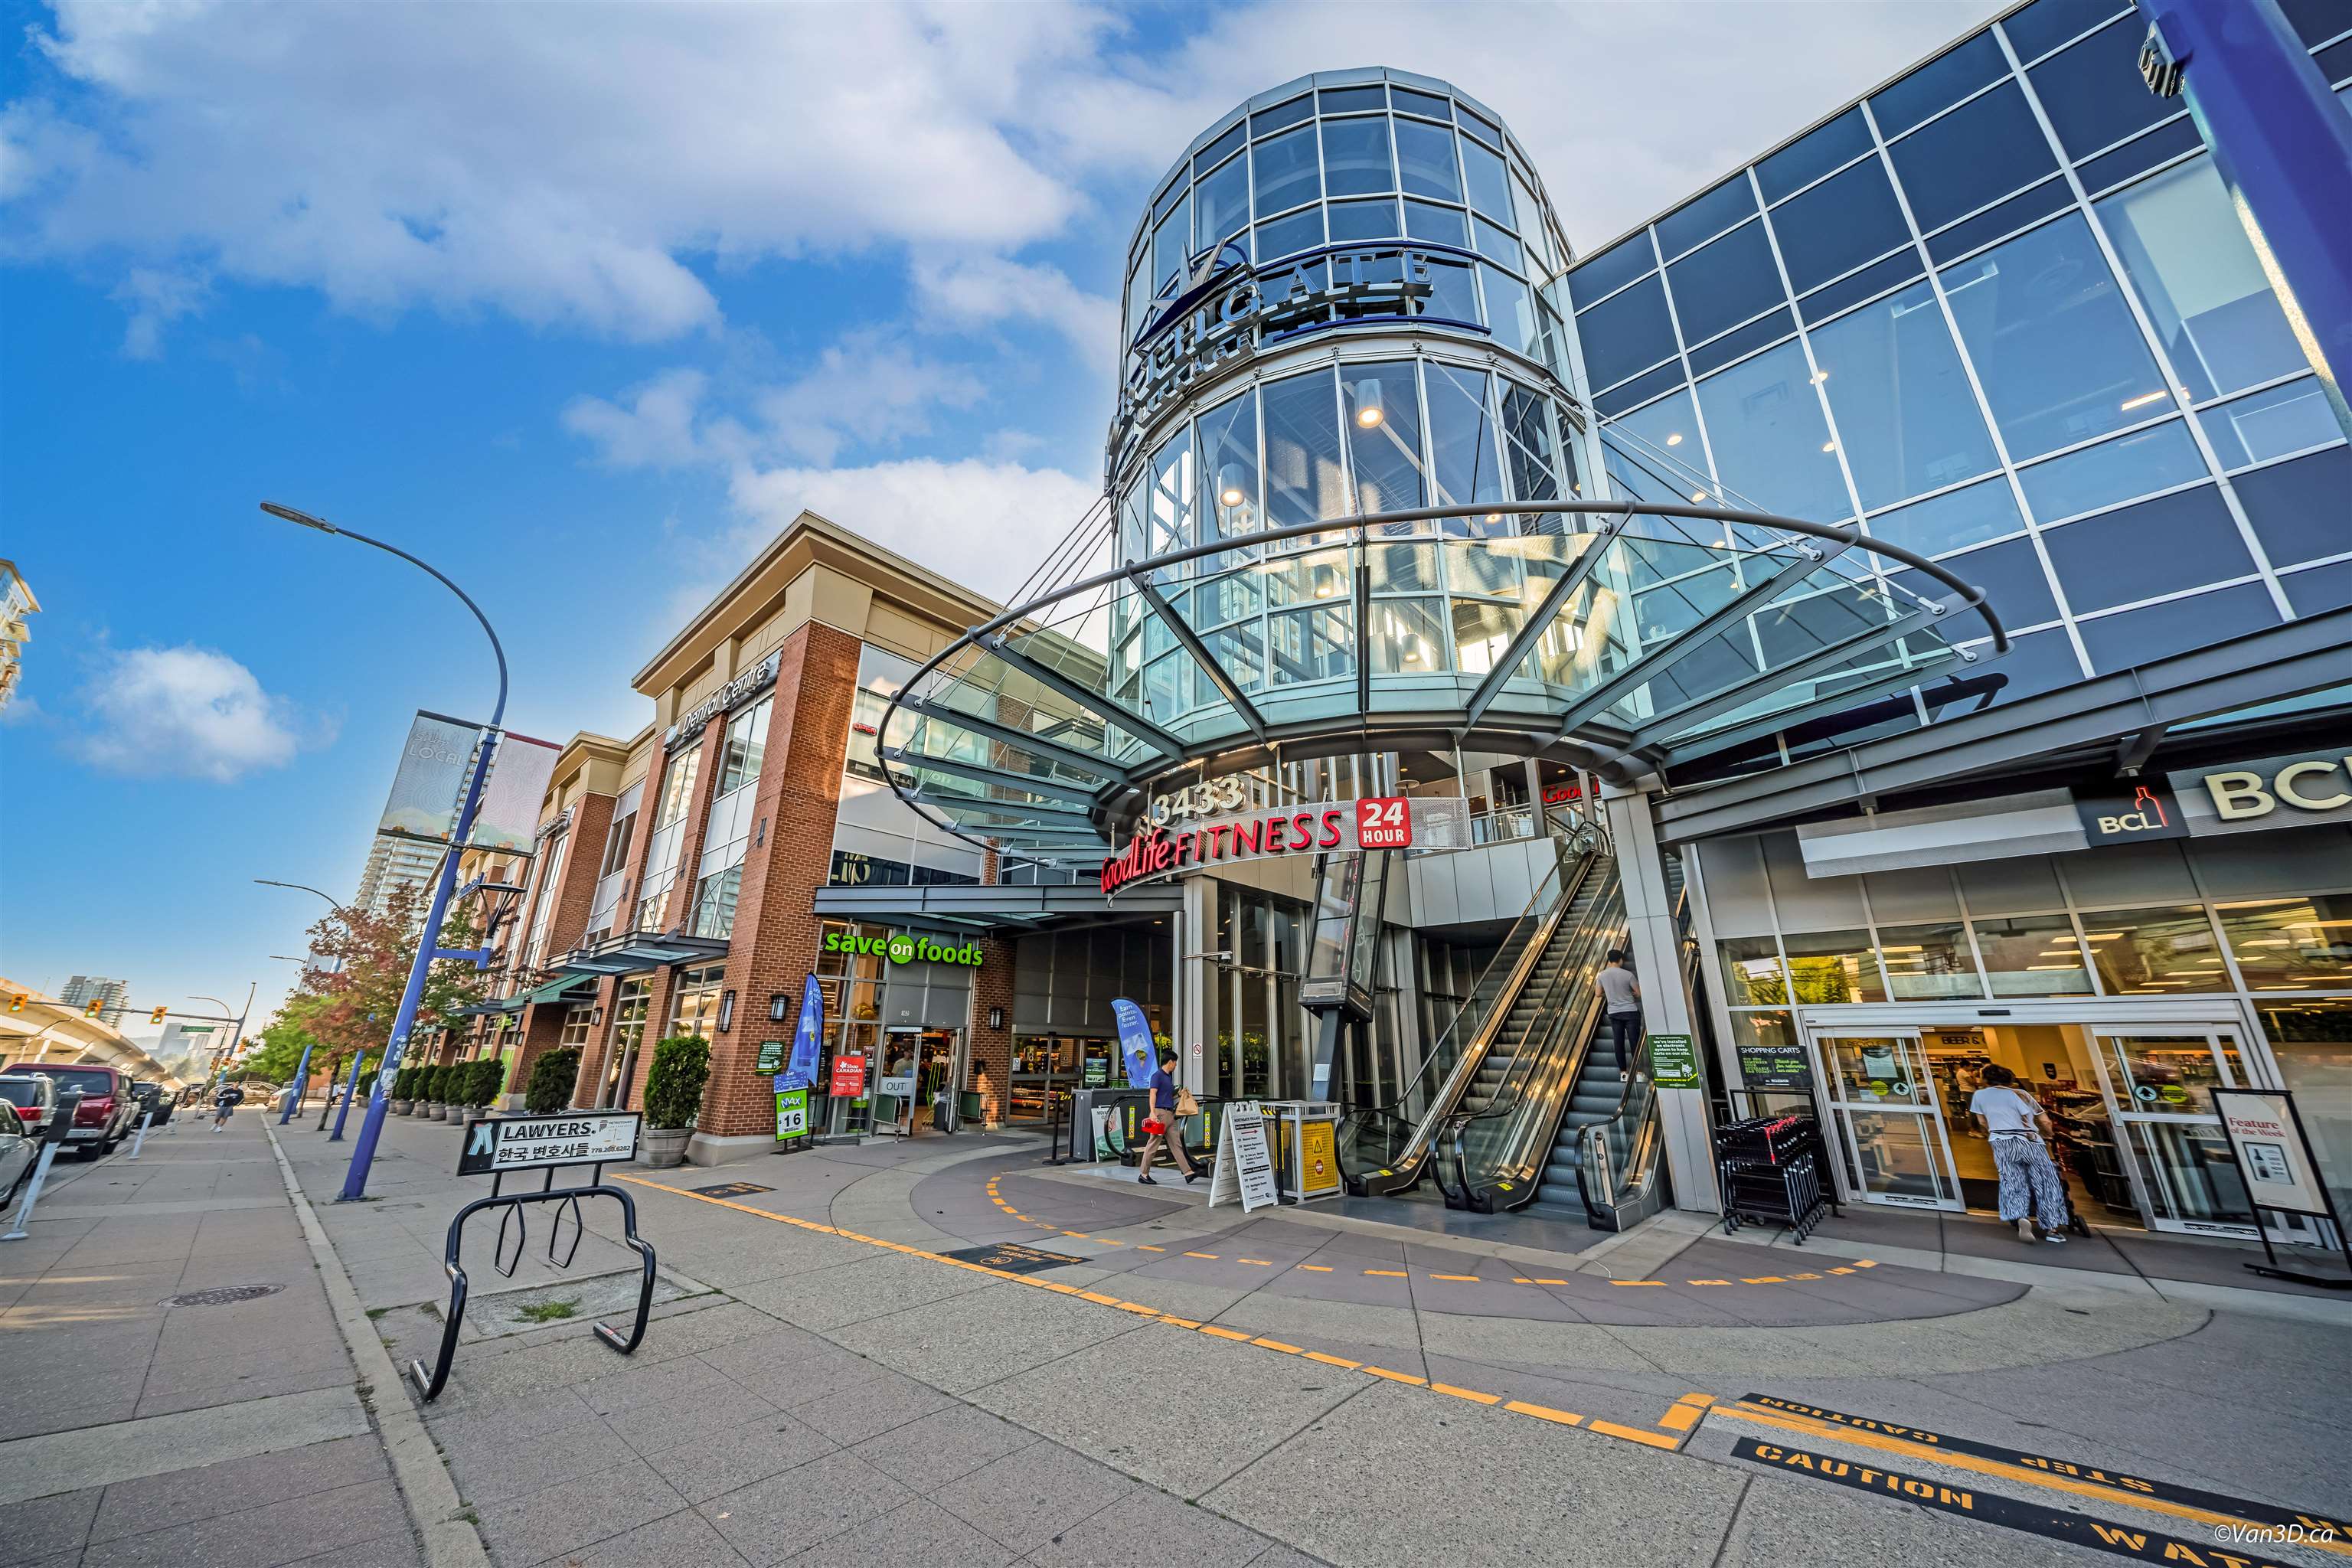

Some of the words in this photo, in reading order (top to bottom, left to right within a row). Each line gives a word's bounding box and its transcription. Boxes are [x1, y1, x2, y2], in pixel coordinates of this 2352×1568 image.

[682, 690, 721, 733] Dental
[722, 661, 767, 704] Centre
[408, 744, 465, 766] LOCAL
[1153, 776, 1246, 825] 3433
[1362, 802, 1405, 828] 24
[2097, 812, 2163, 835] BCL
[1173, 810, 1342, 867] FITNESS
[1363, 828, 1405, 844] HOUR
[825, 933, 887, 956] save
[890, 942, 913, 957] on
[917, 936, 984, 966] foods
[1942, 1037, 1970, 1045] BEER
[886, 1082, 906, 1091] OUT
[781, 1096, 801, 1109] MAX
[503, 1122, 596, 1139] LAWYERS.
[784, 1112, 802, 1128] 16
[2229, 1117, 2279, 1129] Feature
[2258, 1129, 2285, 1138] Week
[498, 1147, 529, 1162] 한국
[532, 1142, 590, 1160] 변호사들
[1759, 1396, 1939, 1444] CAUTION
[1754, 1444, 1974, 1511] CAUTION
[2020, 1457, 2156, 1493] STEP
[2089, 1523, 2278, 1568] WAT
